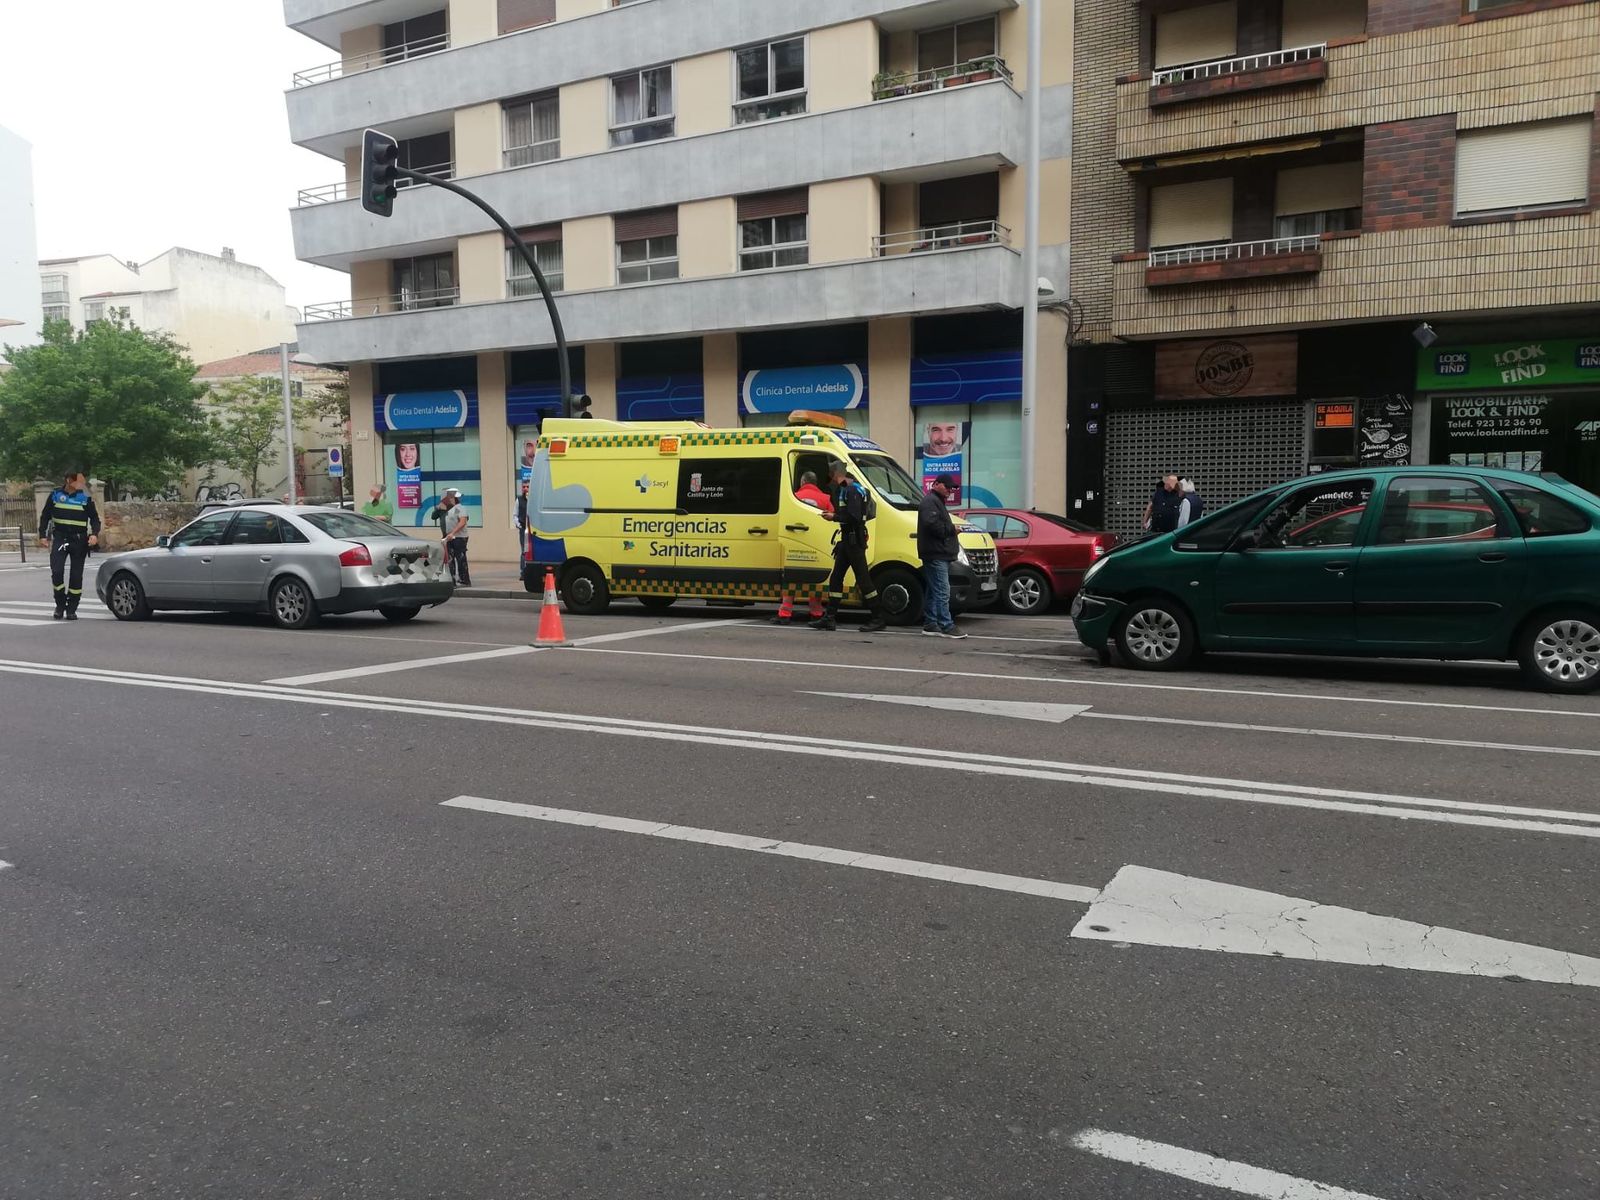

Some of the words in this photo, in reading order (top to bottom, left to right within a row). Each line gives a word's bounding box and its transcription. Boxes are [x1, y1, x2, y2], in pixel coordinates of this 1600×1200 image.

[1494, 344, 1546, 363] LOOK
[1580, 346, 1600, 355] LOO
[1439, 353, 1467, 363] LOOK
[1581, 357, 1600, 366] FIN
[1440, 364, 1465, 374] FIND
[1501, 363, 1546, 384] FIND
[756, 386, 783, 396] Clínica
[785, 384, 813, 395] Dental
[816, 382, 849, 393] Adeslas
[1445, 396, 1548, 408] INMOBILIARIA
[413, 406, 433, 415] Dental
[435, 404, 458, 414] Adeslas
[1318, 405, 1326, 413] SE
[1327, 404, 1353, 413] ALQUILA
[1451, 407, 1486, 418] LOOK
[1489, 407, 1502, 417] &
[1507, 406, 1540, 416] FIND
[1476, 420, 1495, 428] 923
[1499, 419, 1511, 427] 12
[1513, 419, 1526, 427] 36
[1529, 418, 1542, 426] 90
[1450, 427, 1550, 438] www.lookandfind.es
[652, 480, 668, 488] Sacyl
[623, 517, 727, 538] Emergencias
[649, 541, 730, 558] Sanitarias
